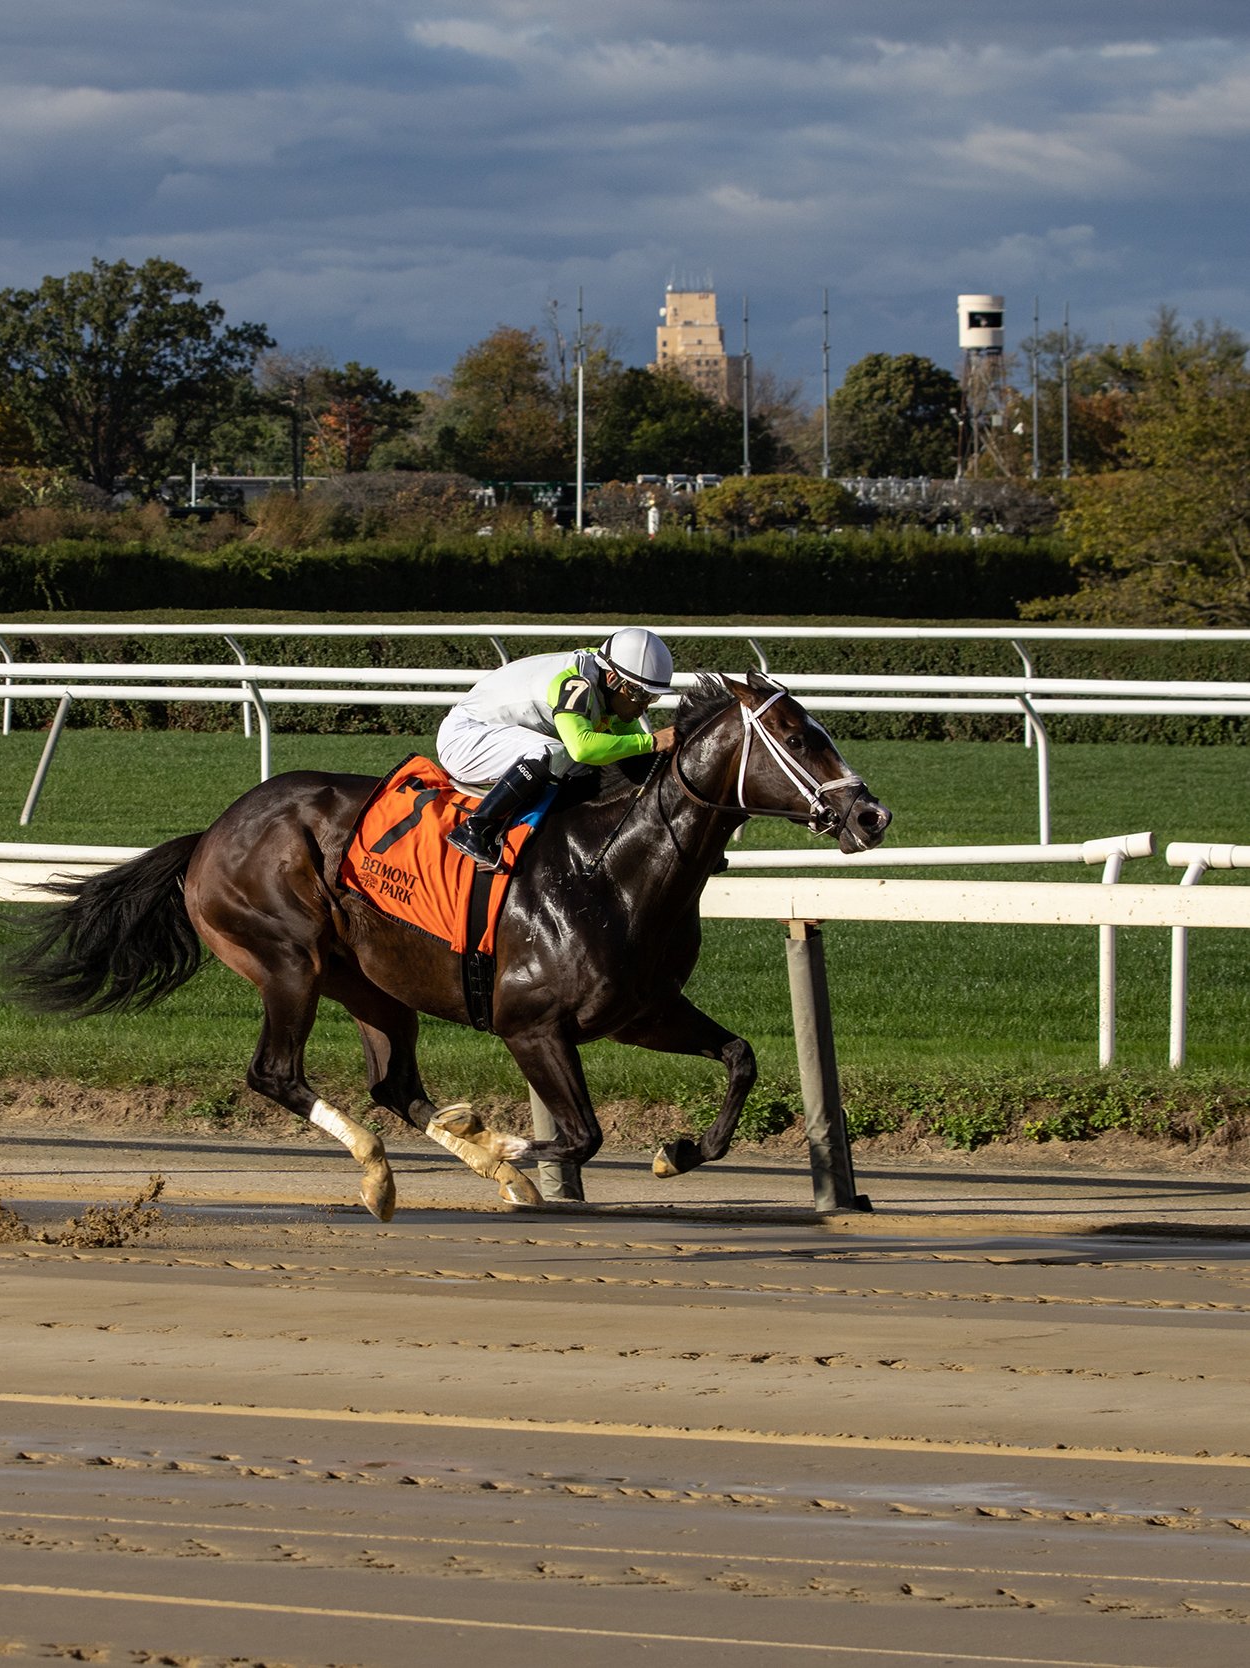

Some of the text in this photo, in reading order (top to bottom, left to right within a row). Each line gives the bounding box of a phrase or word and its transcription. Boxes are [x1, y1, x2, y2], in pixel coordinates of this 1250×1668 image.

[564, 680, 590, 710] 7
[369, 777, 440, 854] 7
[360, 856, 419, 889] BELMONT
[379, 880, 414, 906] PARK
